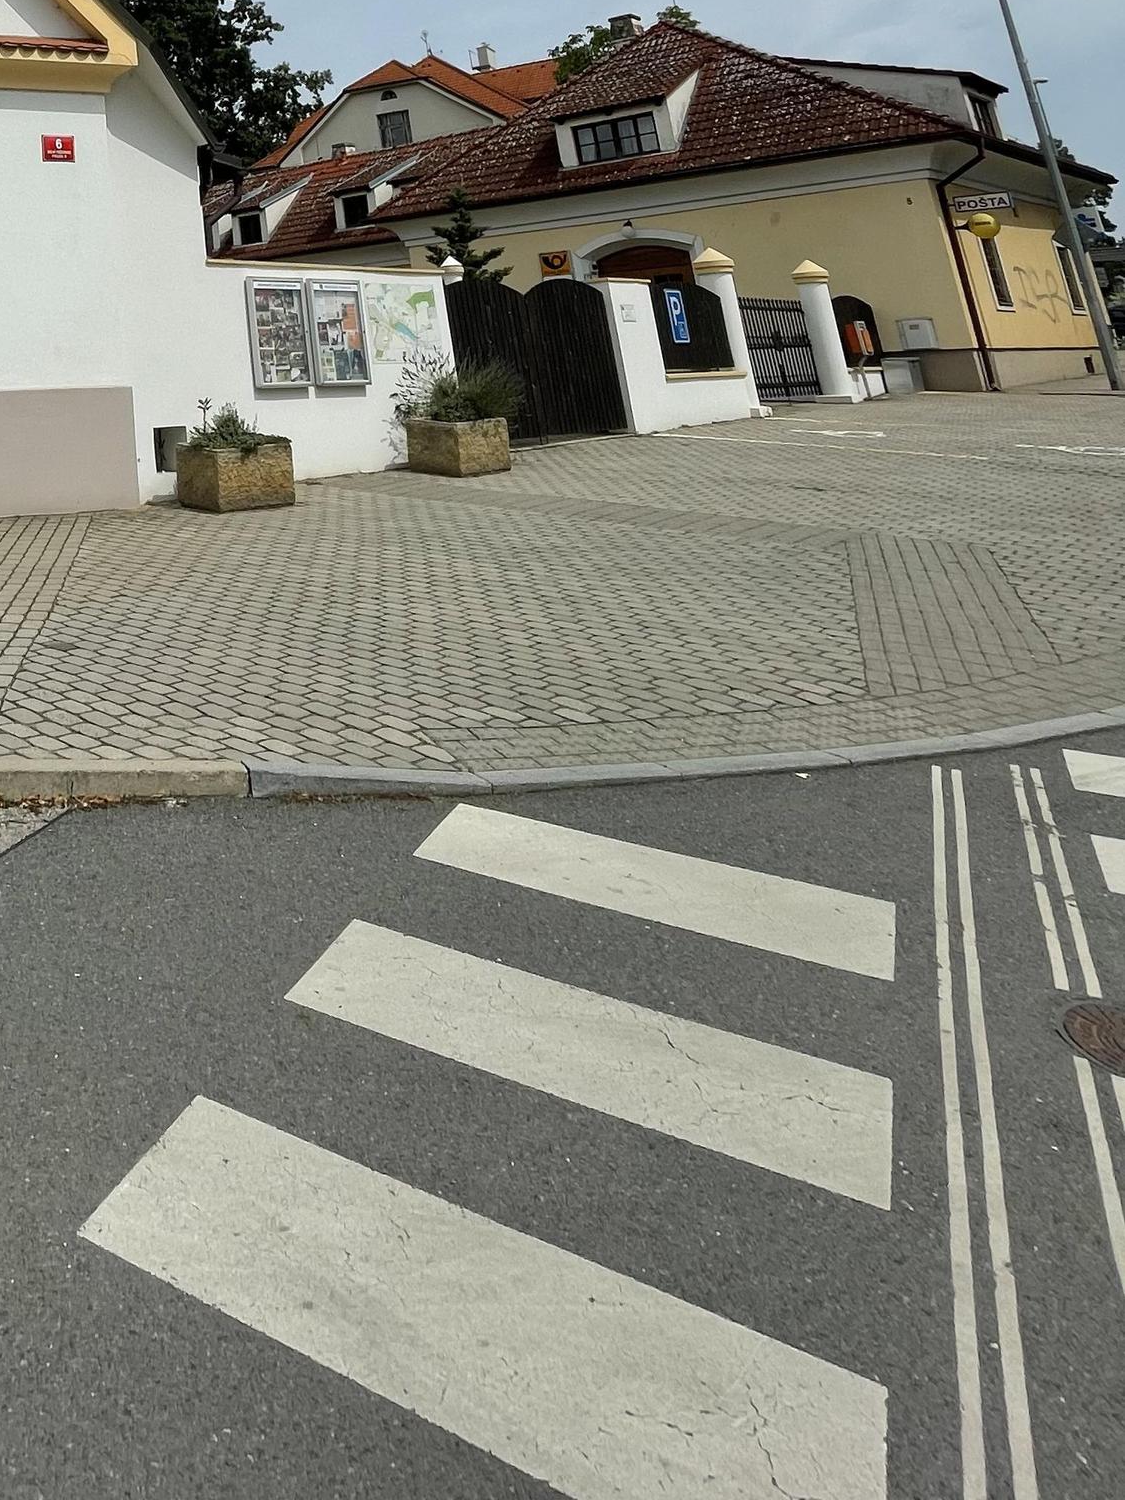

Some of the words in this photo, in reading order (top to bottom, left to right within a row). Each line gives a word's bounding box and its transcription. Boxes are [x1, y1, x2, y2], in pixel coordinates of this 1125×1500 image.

[55, 138, 63, 150] 6
[956, 196, 1009, 210] POŠTA
[669, 296, 681, 326] P
